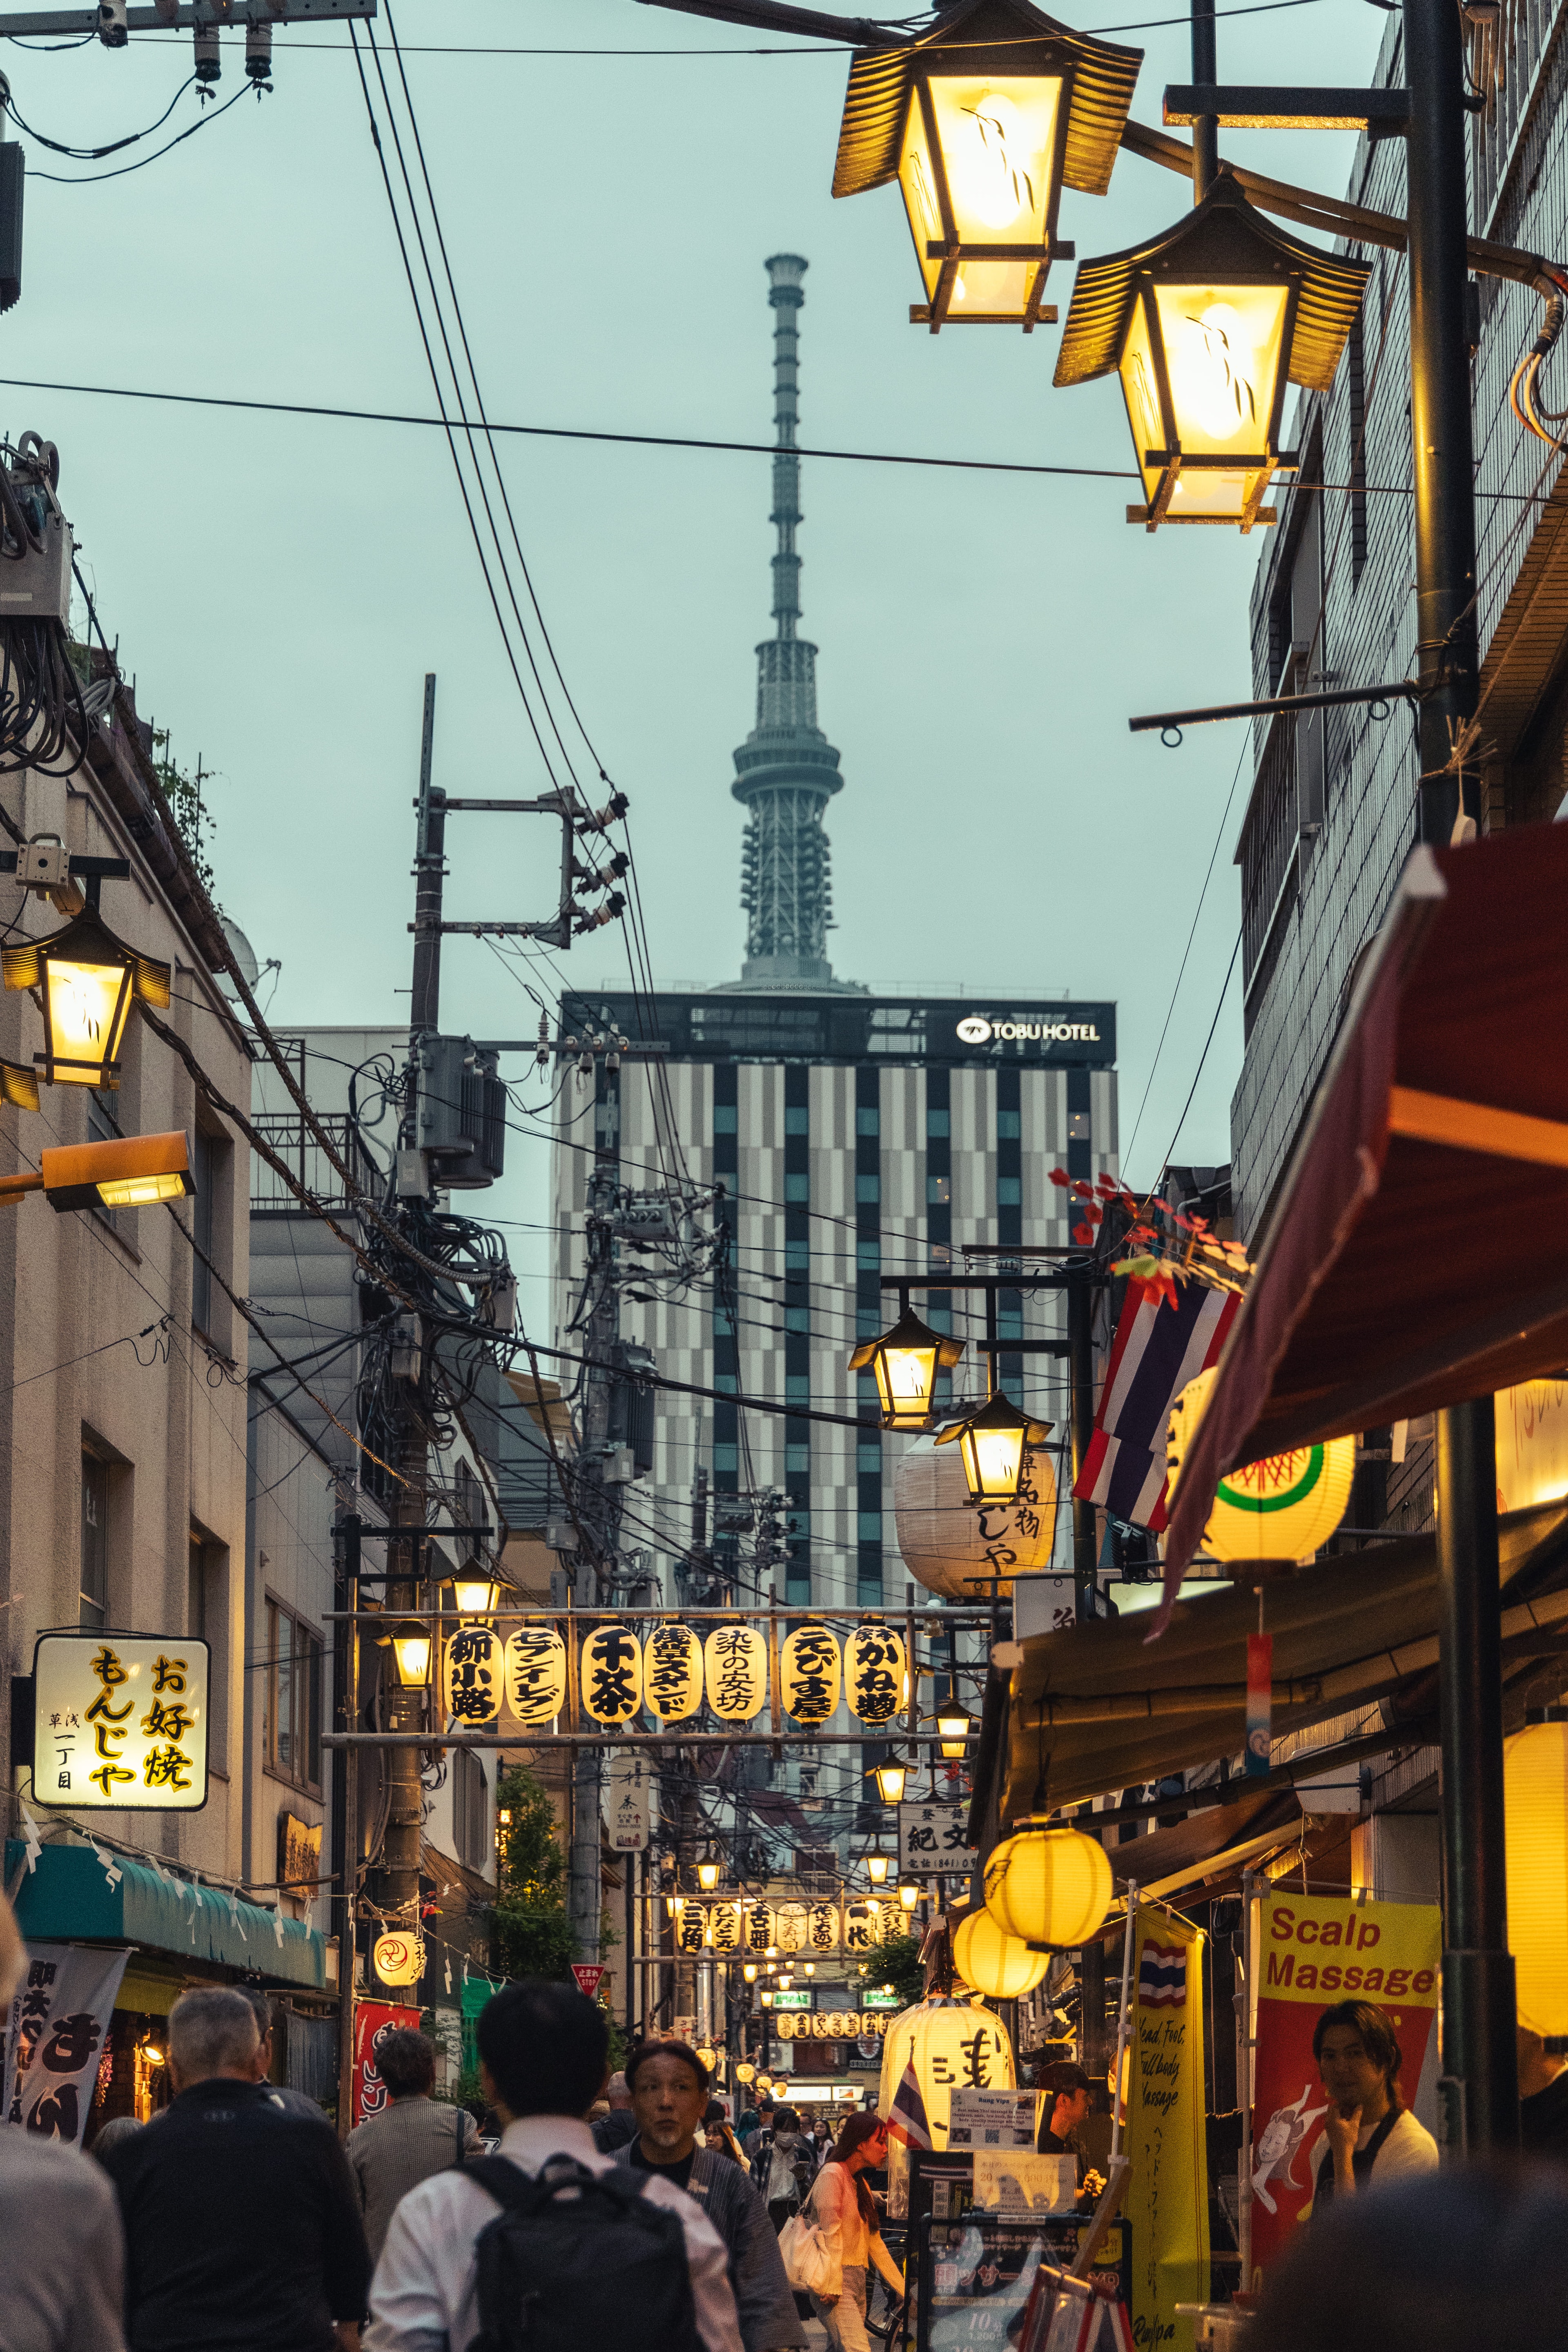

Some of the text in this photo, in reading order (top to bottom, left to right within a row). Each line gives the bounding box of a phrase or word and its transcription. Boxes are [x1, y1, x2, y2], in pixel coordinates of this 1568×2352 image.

[991, 1023, 1100, 1041] TOBU HOTEL
[511, 1631, 562, 1719] セブンイレブン
[715, 1630, 755, 1712] 染の安坊
[1270, 1907, 1381, 1951] Scalp
[579, 1969, 599, 1977] 止まれ
[1267, 1953, 1434, 1996] Massage
